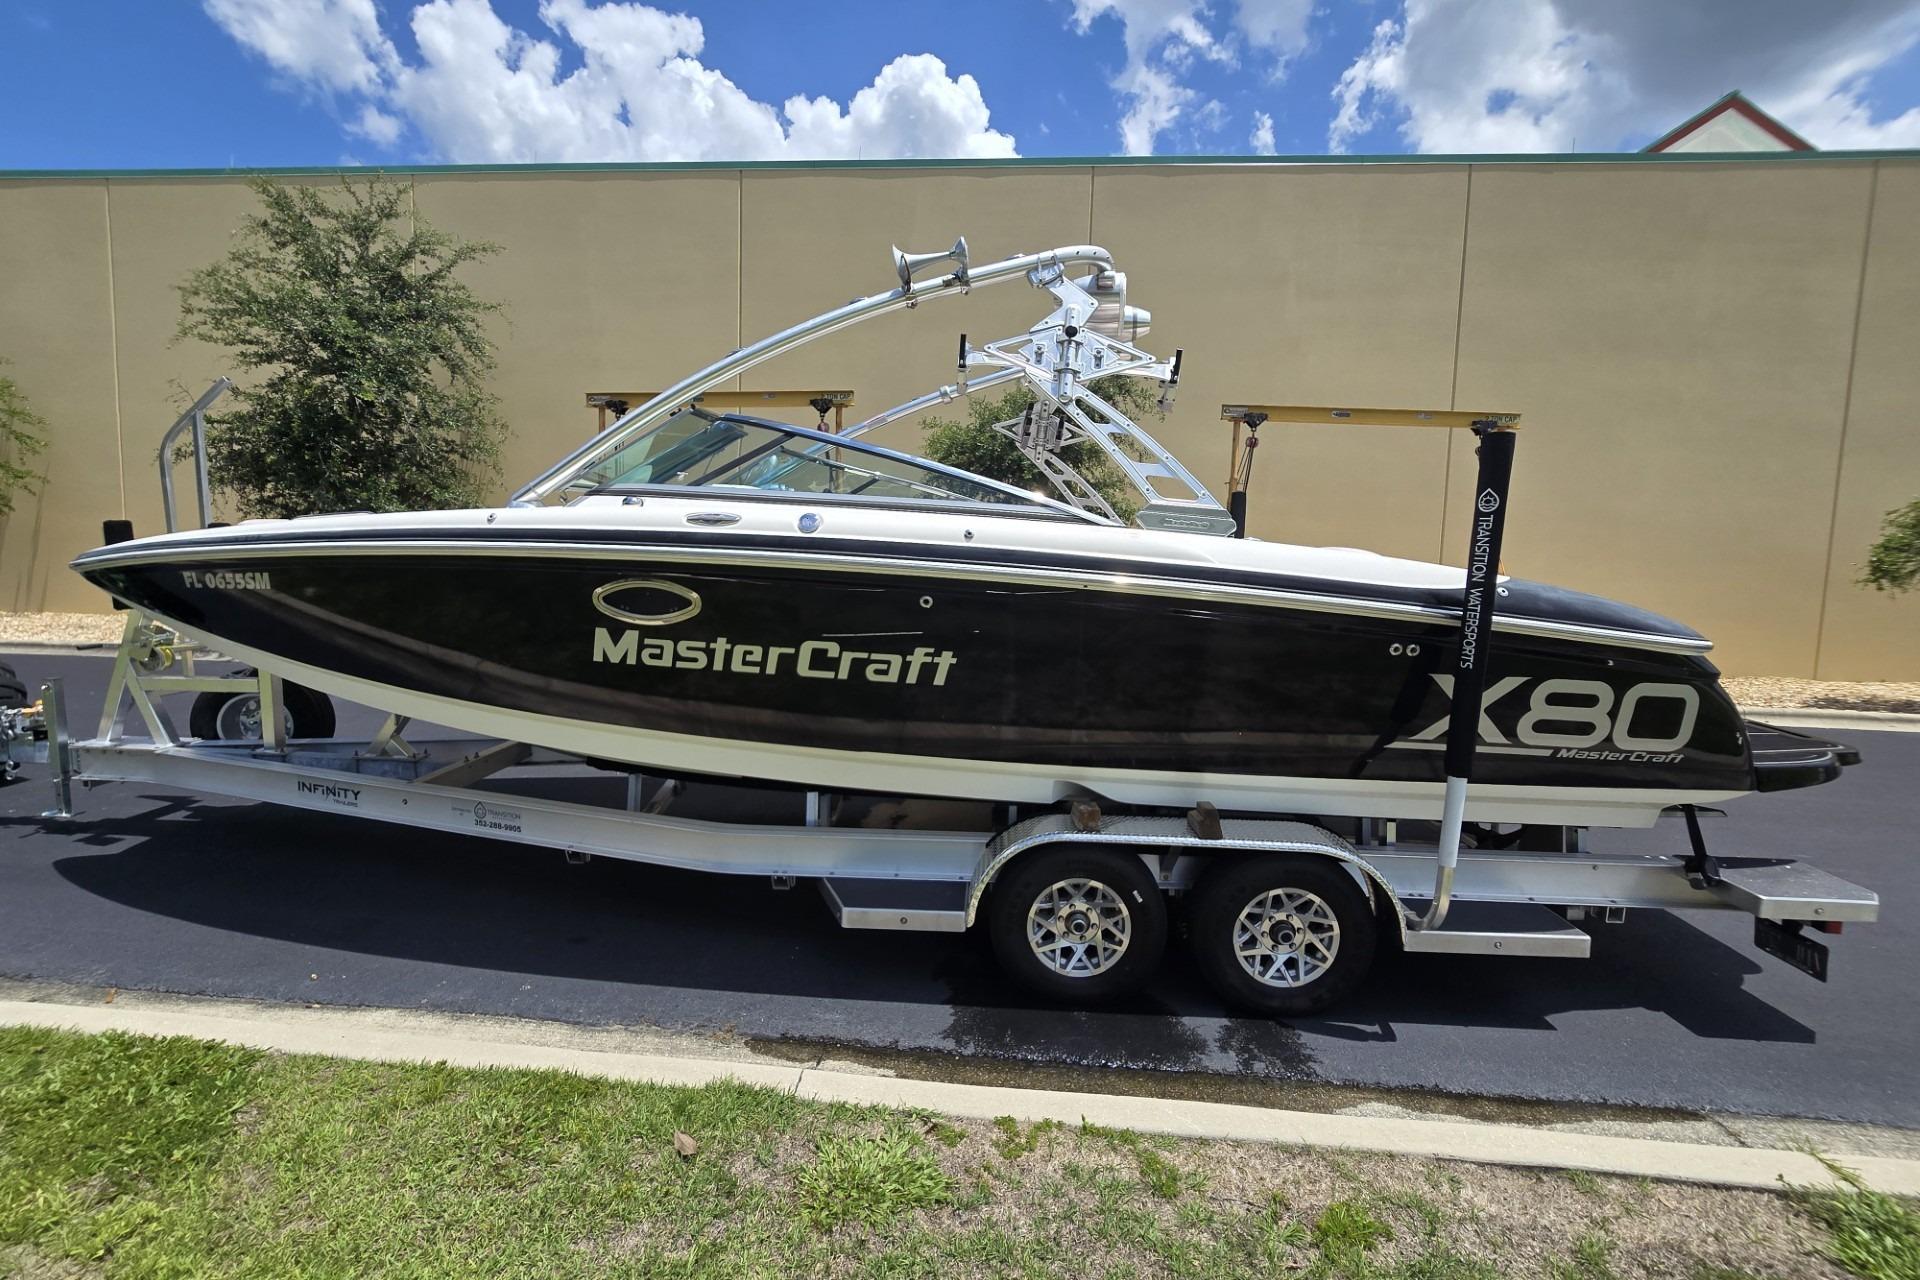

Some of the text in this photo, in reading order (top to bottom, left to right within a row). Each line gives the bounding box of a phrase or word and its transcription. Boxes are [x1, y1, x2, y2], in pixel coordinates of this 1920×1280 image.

[182, 571, 271, 590] FL 0655SM
[1460, 515, 1493, 669] TRANSITION WATERSPORTS
[593, 627, 958, 686] MasterCraft
[1408, 673, 1700, 752] X80
[1556, 748, 1685, 763] MasterCraft
